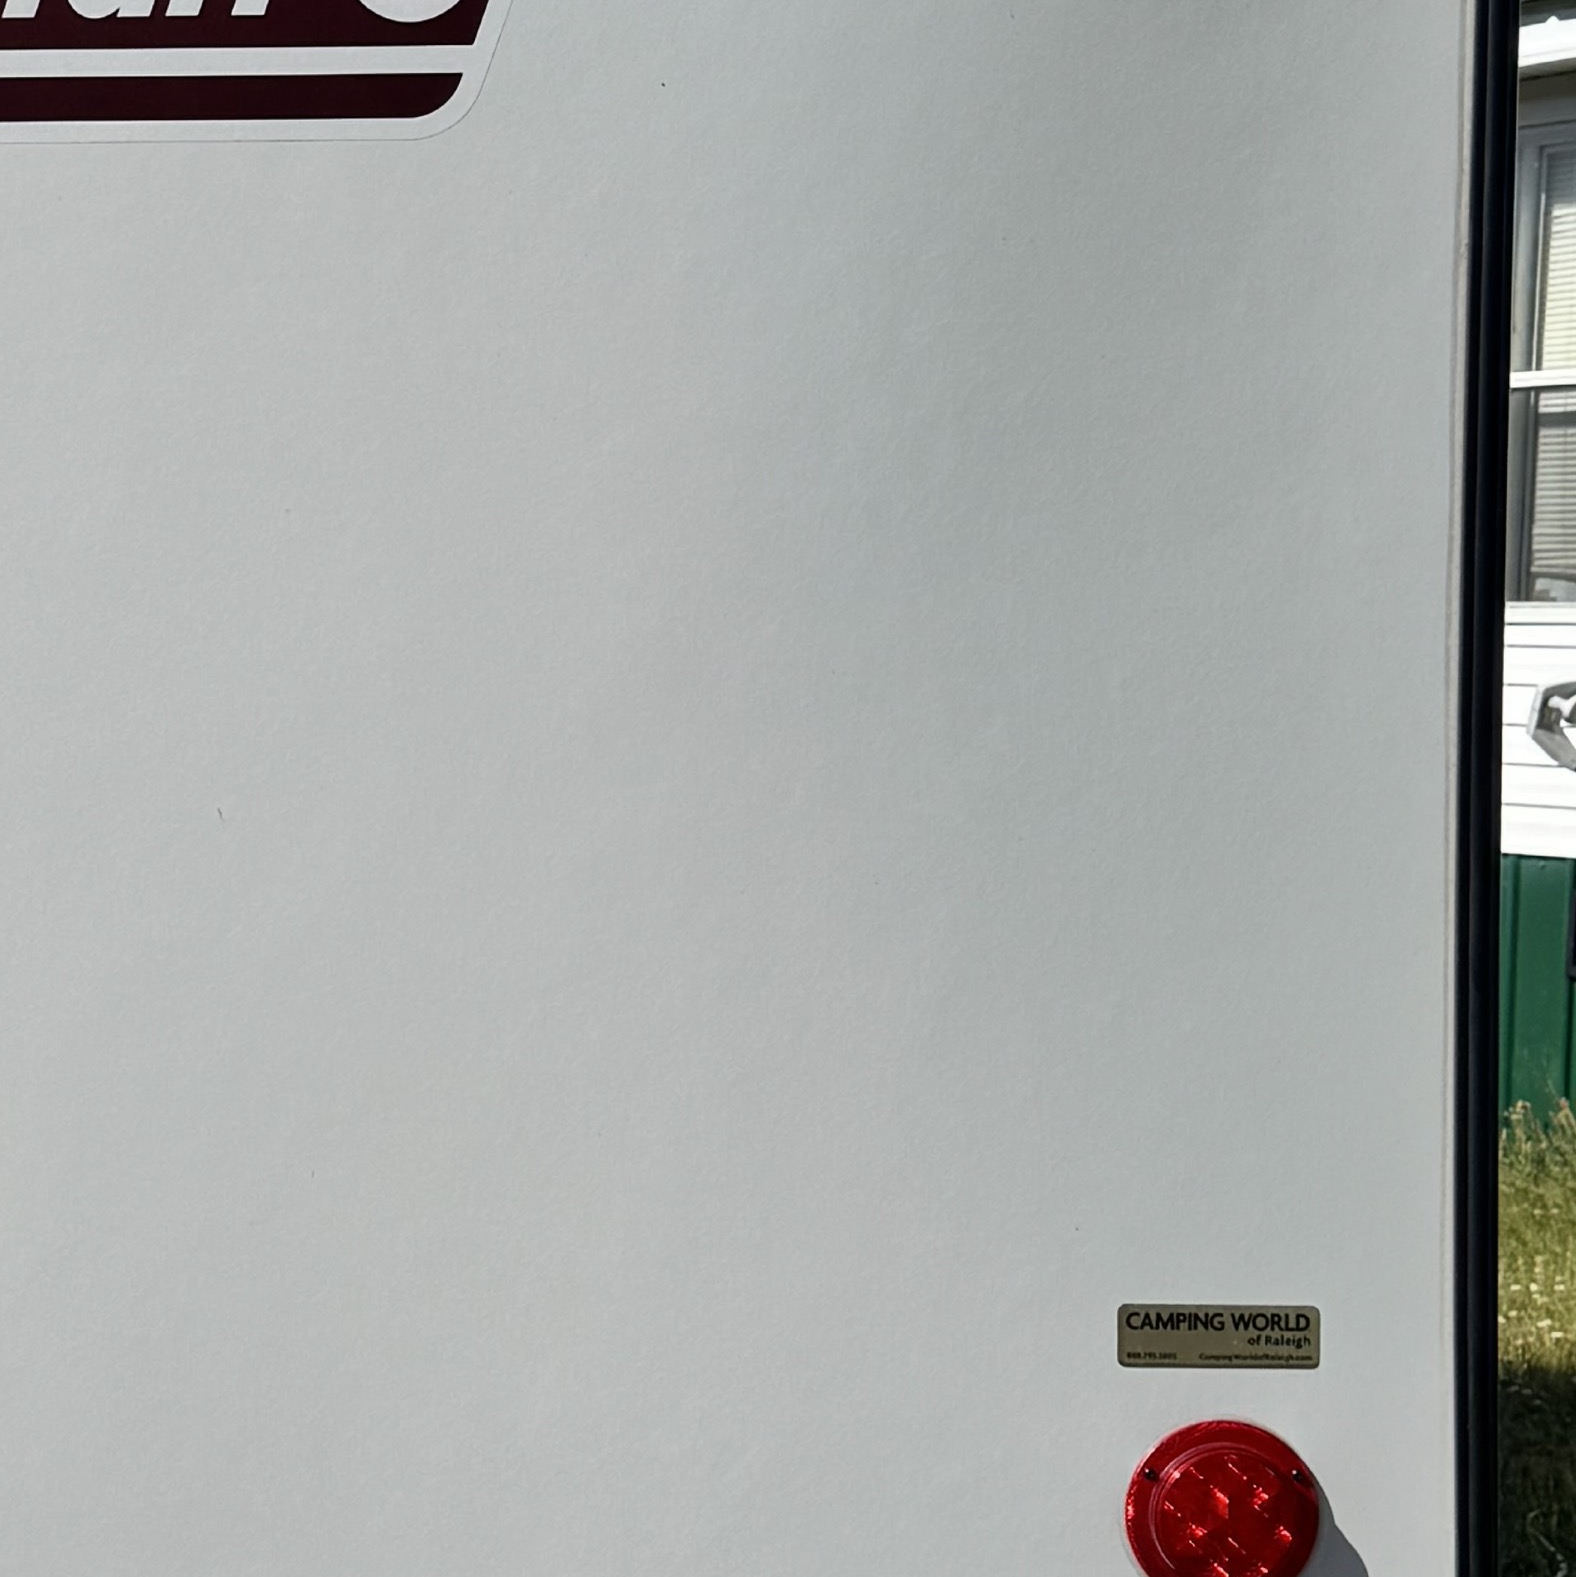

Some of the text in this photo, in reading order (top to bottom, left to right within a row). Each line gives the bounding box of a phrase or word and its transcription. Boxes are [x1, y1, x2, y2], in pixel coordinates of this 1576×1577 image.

[1126, 1312, 1310, 1332] CAMPING WORLD
[1247, 1335, 1311, 1349] of Raleigh
